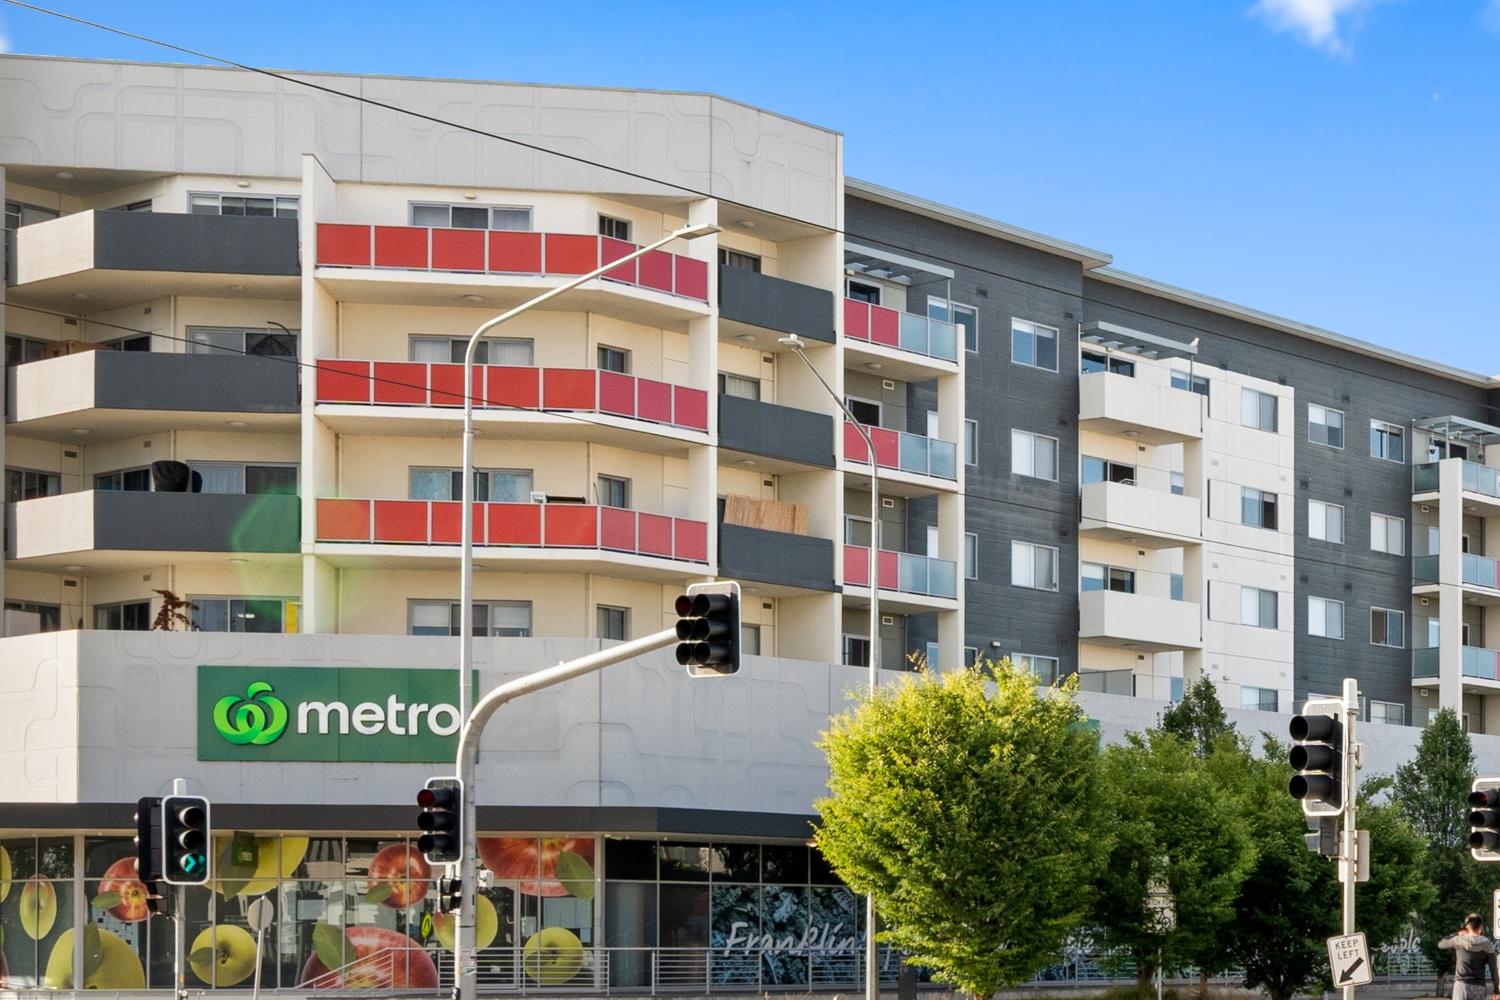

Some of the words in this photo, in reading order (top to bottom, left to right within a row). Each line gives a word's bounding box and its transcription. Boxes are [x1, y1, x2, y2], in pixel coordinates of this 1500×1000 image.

[298, 694, 461, 736] metro
[1335, 939, 1359, 950] KEEP
[1337, 949, 1359, 960] LEFT
